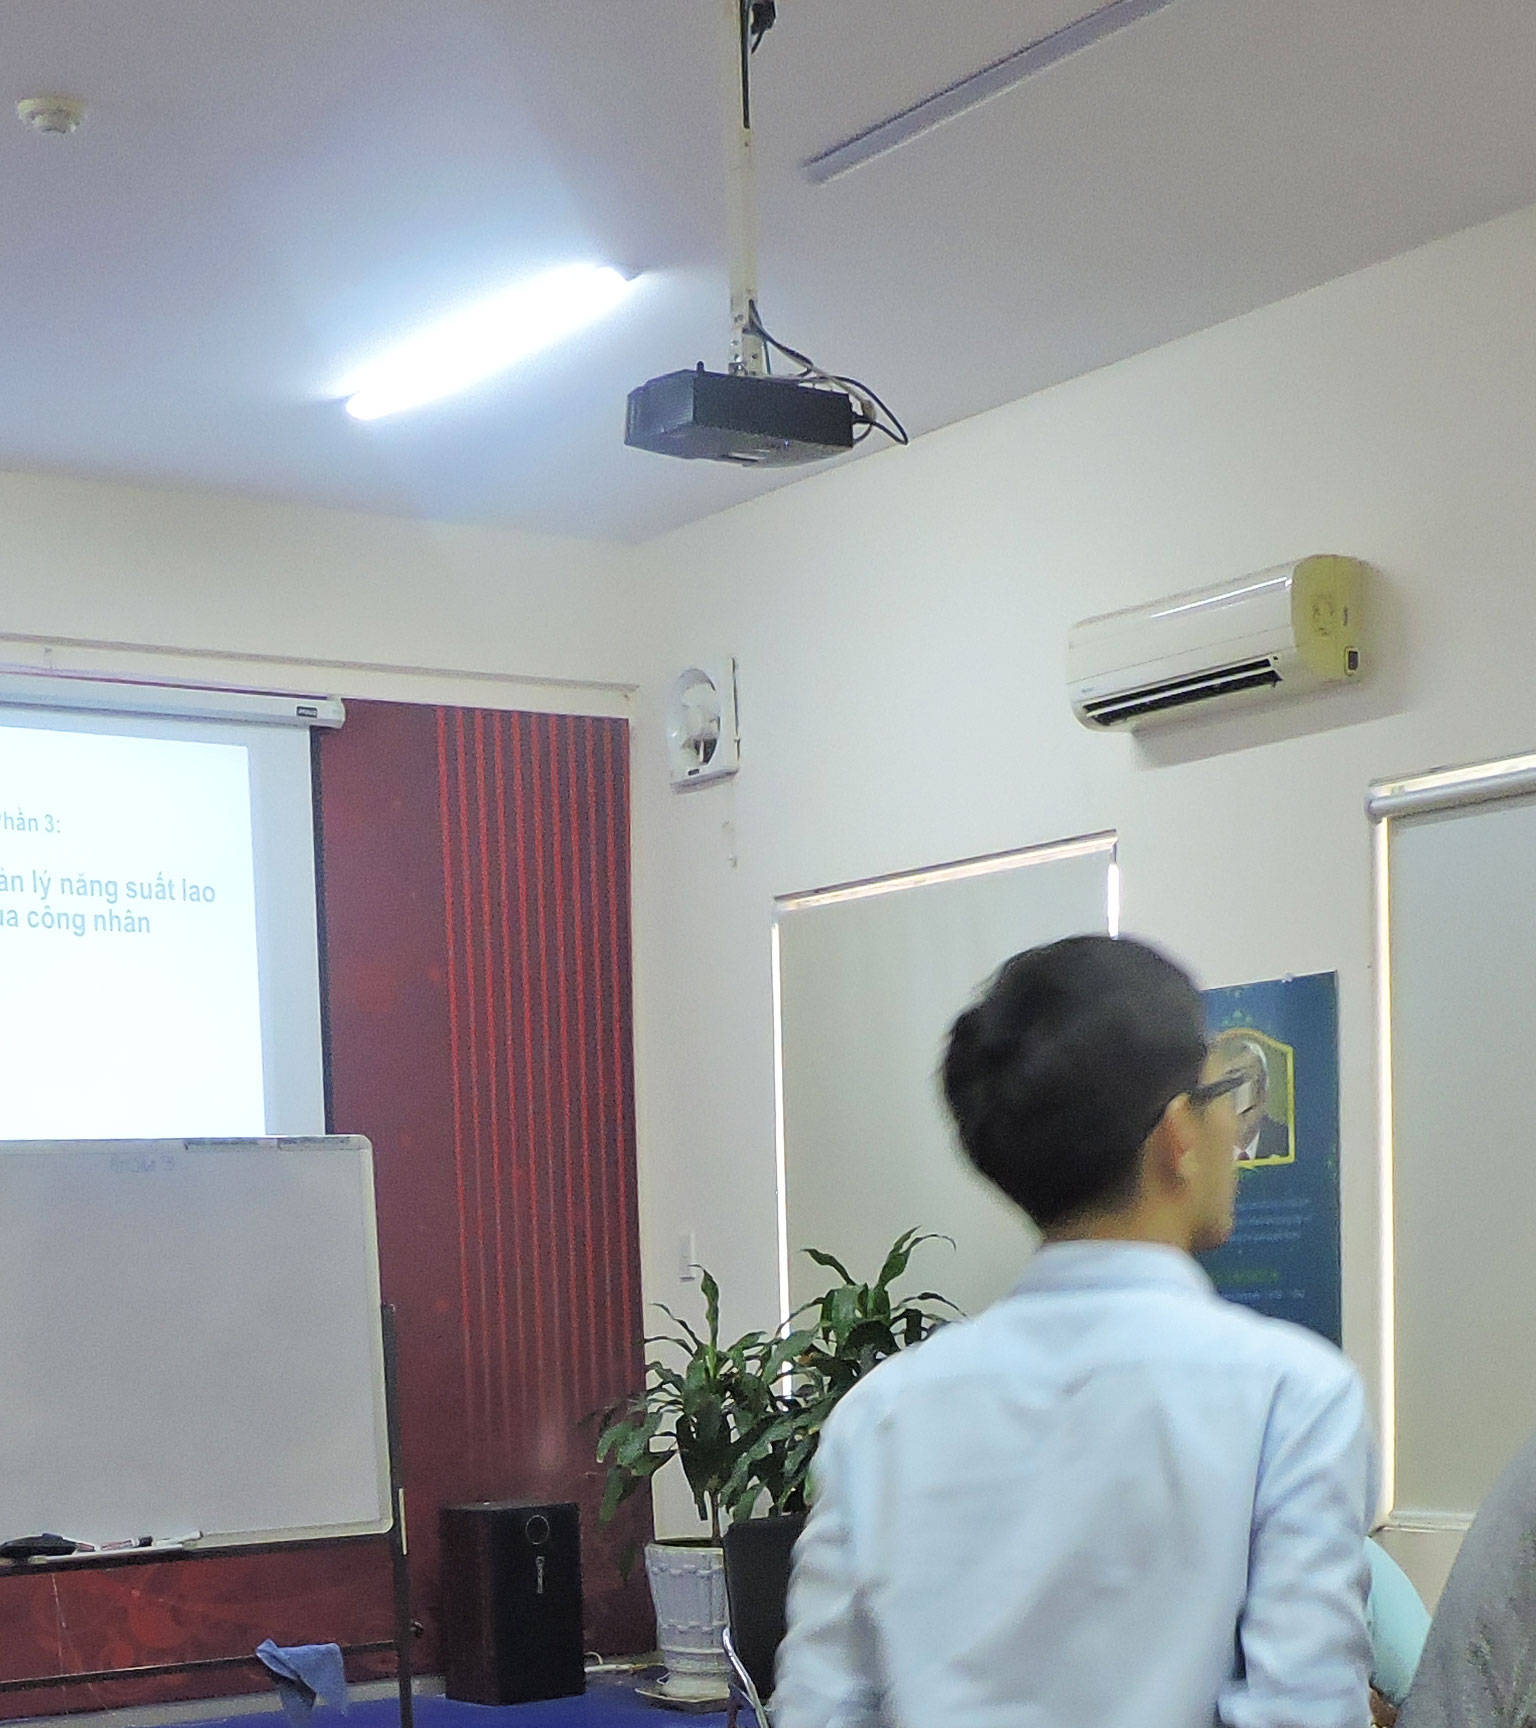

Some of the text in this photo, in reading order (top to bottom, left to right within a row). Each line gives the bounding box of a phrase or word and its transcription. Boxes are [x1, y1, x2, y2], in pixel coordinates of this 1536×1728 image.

[44, 813, 61, 834] 3:
[32, 869, 52, 900] lý
[60, 872, 119, 904] năng
[125, 871, 176, 901] suất
[182, 878, 216, 903] lao
[27, 905, 86, 937] công
[93, 908, 151, 934] nhân
